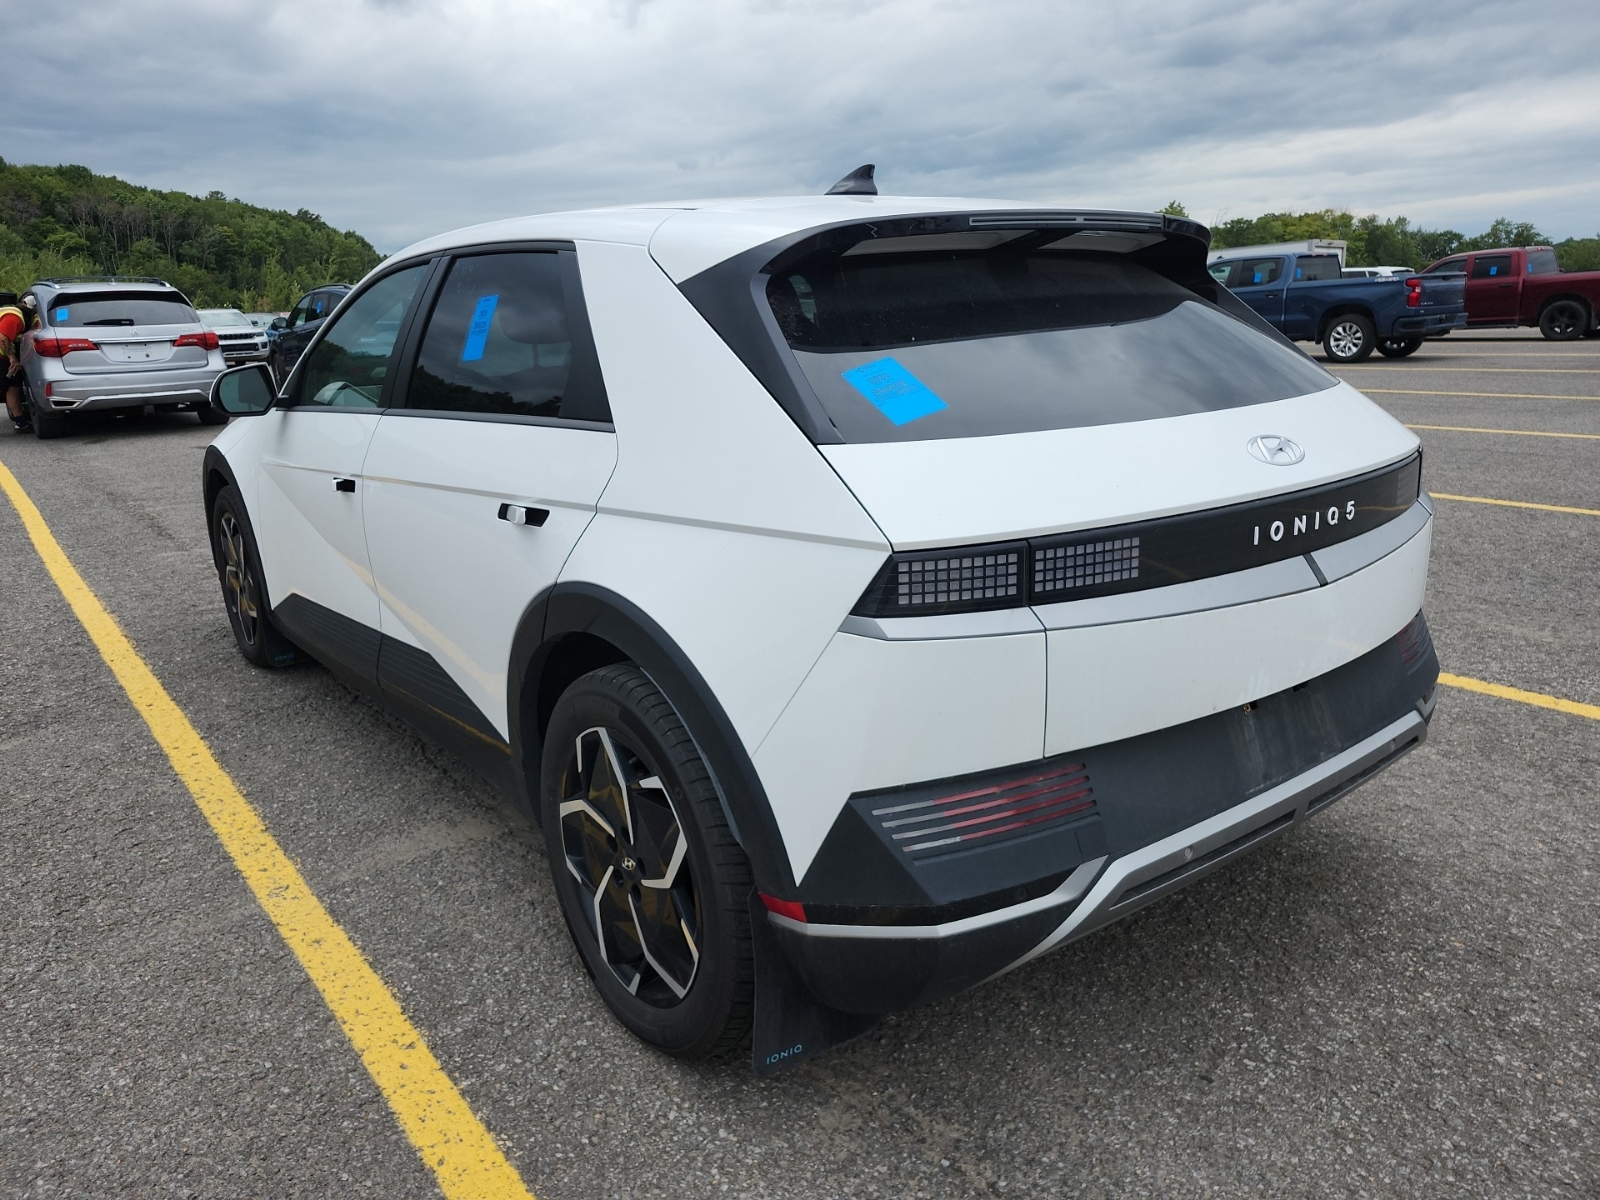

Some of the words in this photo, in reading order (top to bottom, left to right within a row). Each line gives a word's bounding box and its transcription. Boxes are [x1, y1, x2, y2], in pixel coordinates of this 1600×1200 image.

[1253, 506, 1339, 545] IONIQ
[1345, 500, 1355, 520] 5
[766, 1044, 803, 1065] IONIQ
